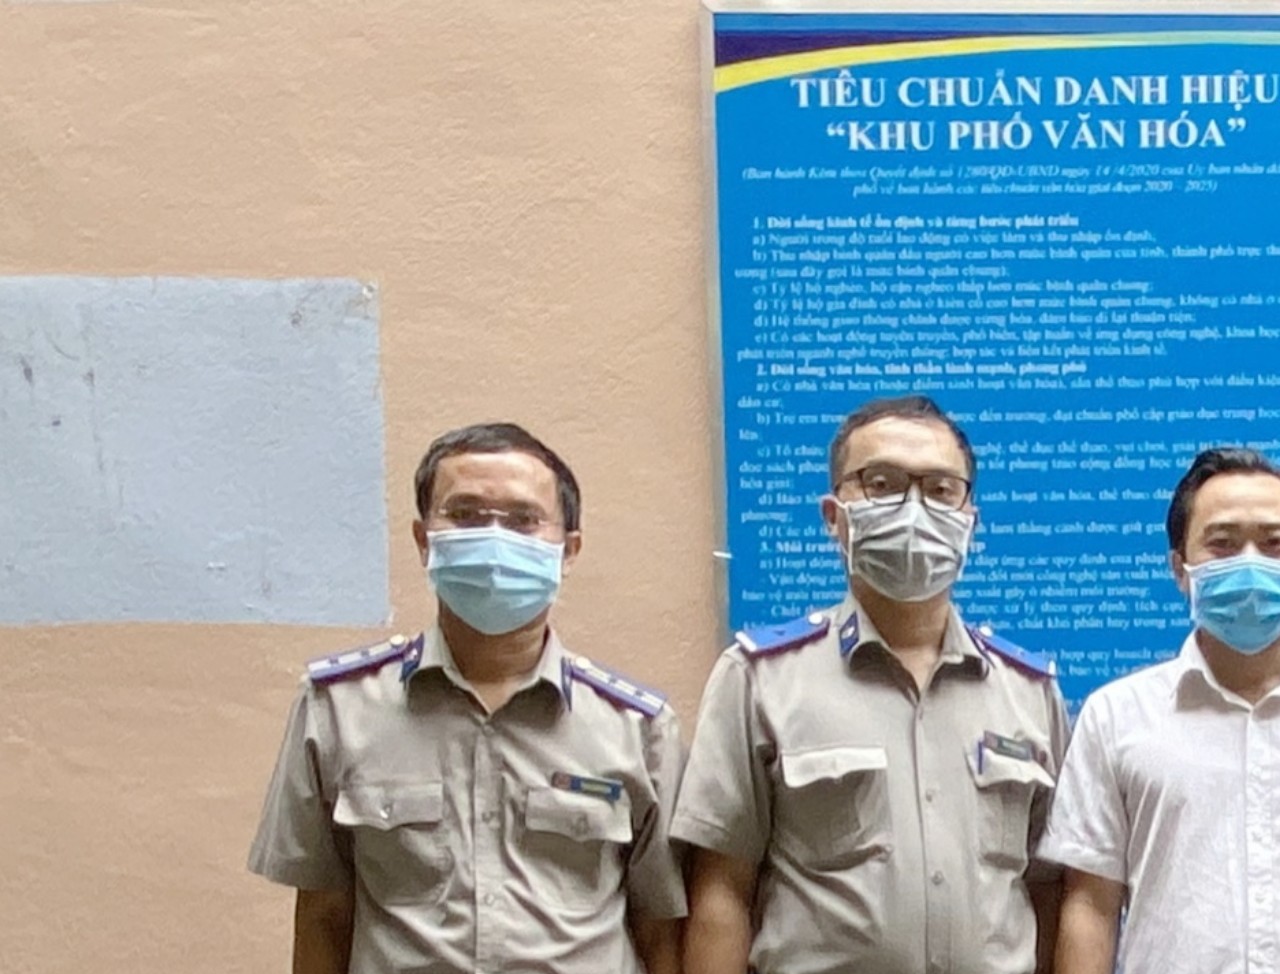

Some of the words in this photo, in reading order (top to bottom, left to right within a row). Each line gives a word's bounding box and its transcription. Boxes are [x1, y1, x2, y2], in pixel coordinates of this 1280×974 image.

[791, 69, 885, 107] TIÊU
[896, 68, 1041, 107] CHUẨN
[1054, 75, 1168, 105] DANH
[1180, 69, 1279, 109] HIỆU
[825, 119, 935, 152] “KHU
[947, 114, 1034, 151] PHỐ
[1041, 112, 1126, 149] VĂN
[1138, 109, 1247, 149] HÓA”
